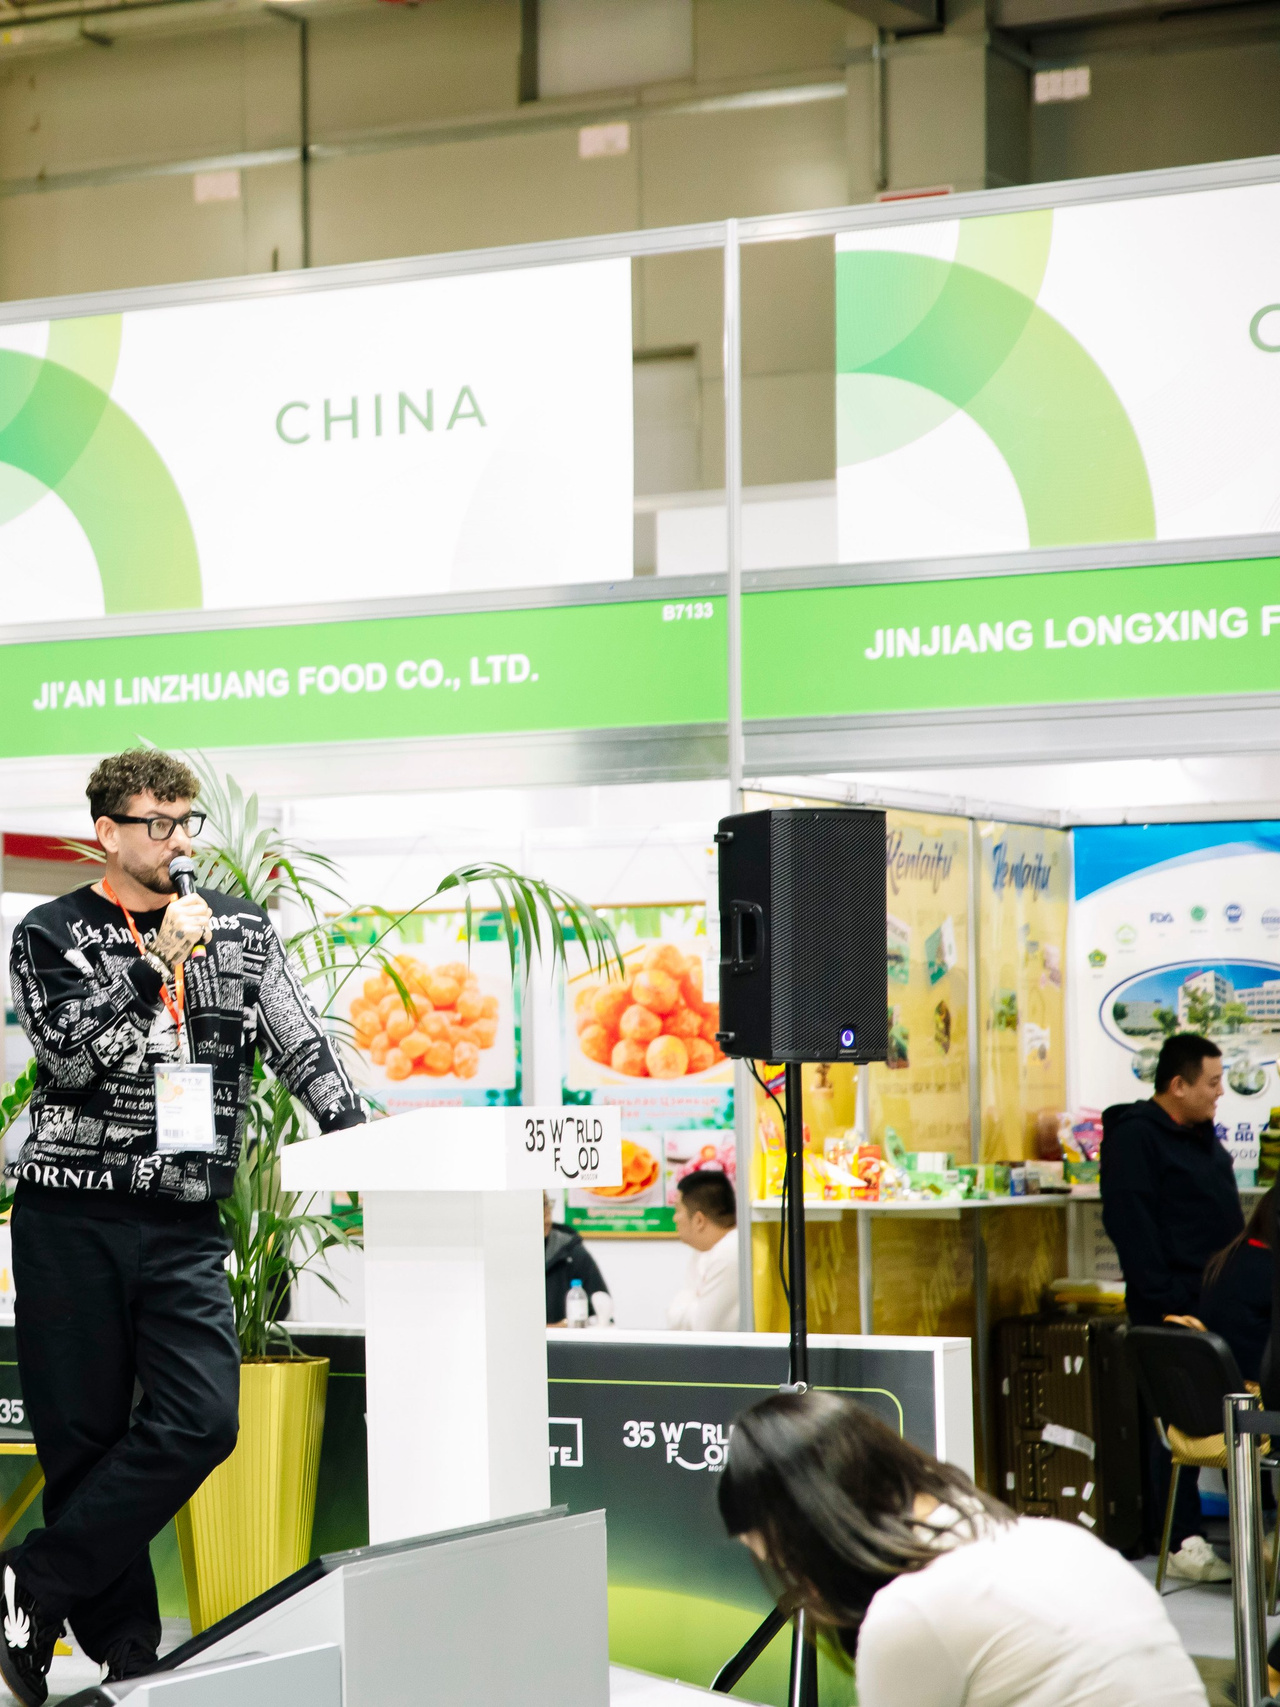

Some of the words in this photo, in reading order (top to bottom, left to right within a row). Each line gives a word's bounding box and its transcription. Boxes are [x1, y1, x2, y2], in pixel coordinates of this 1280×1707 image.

[274, 384, 489, 445] CHINA
[662, 602, 714, 622] B7133
[864, 620, 1034, 660] JINJIANG
[1044, 606, 1249, 650] LONGXING
[33, 679, 107, 711] JI'AN
[113, 668, 289, 708] LINZHUANG
[297, 662, 388, 696] FOOD
[395, 658, 462, 693] CO.,
[469, 653, 540, 686] LTD.
[525, 1118, 546, 1152] 35
[622, 1420, 656, 1449] 35
